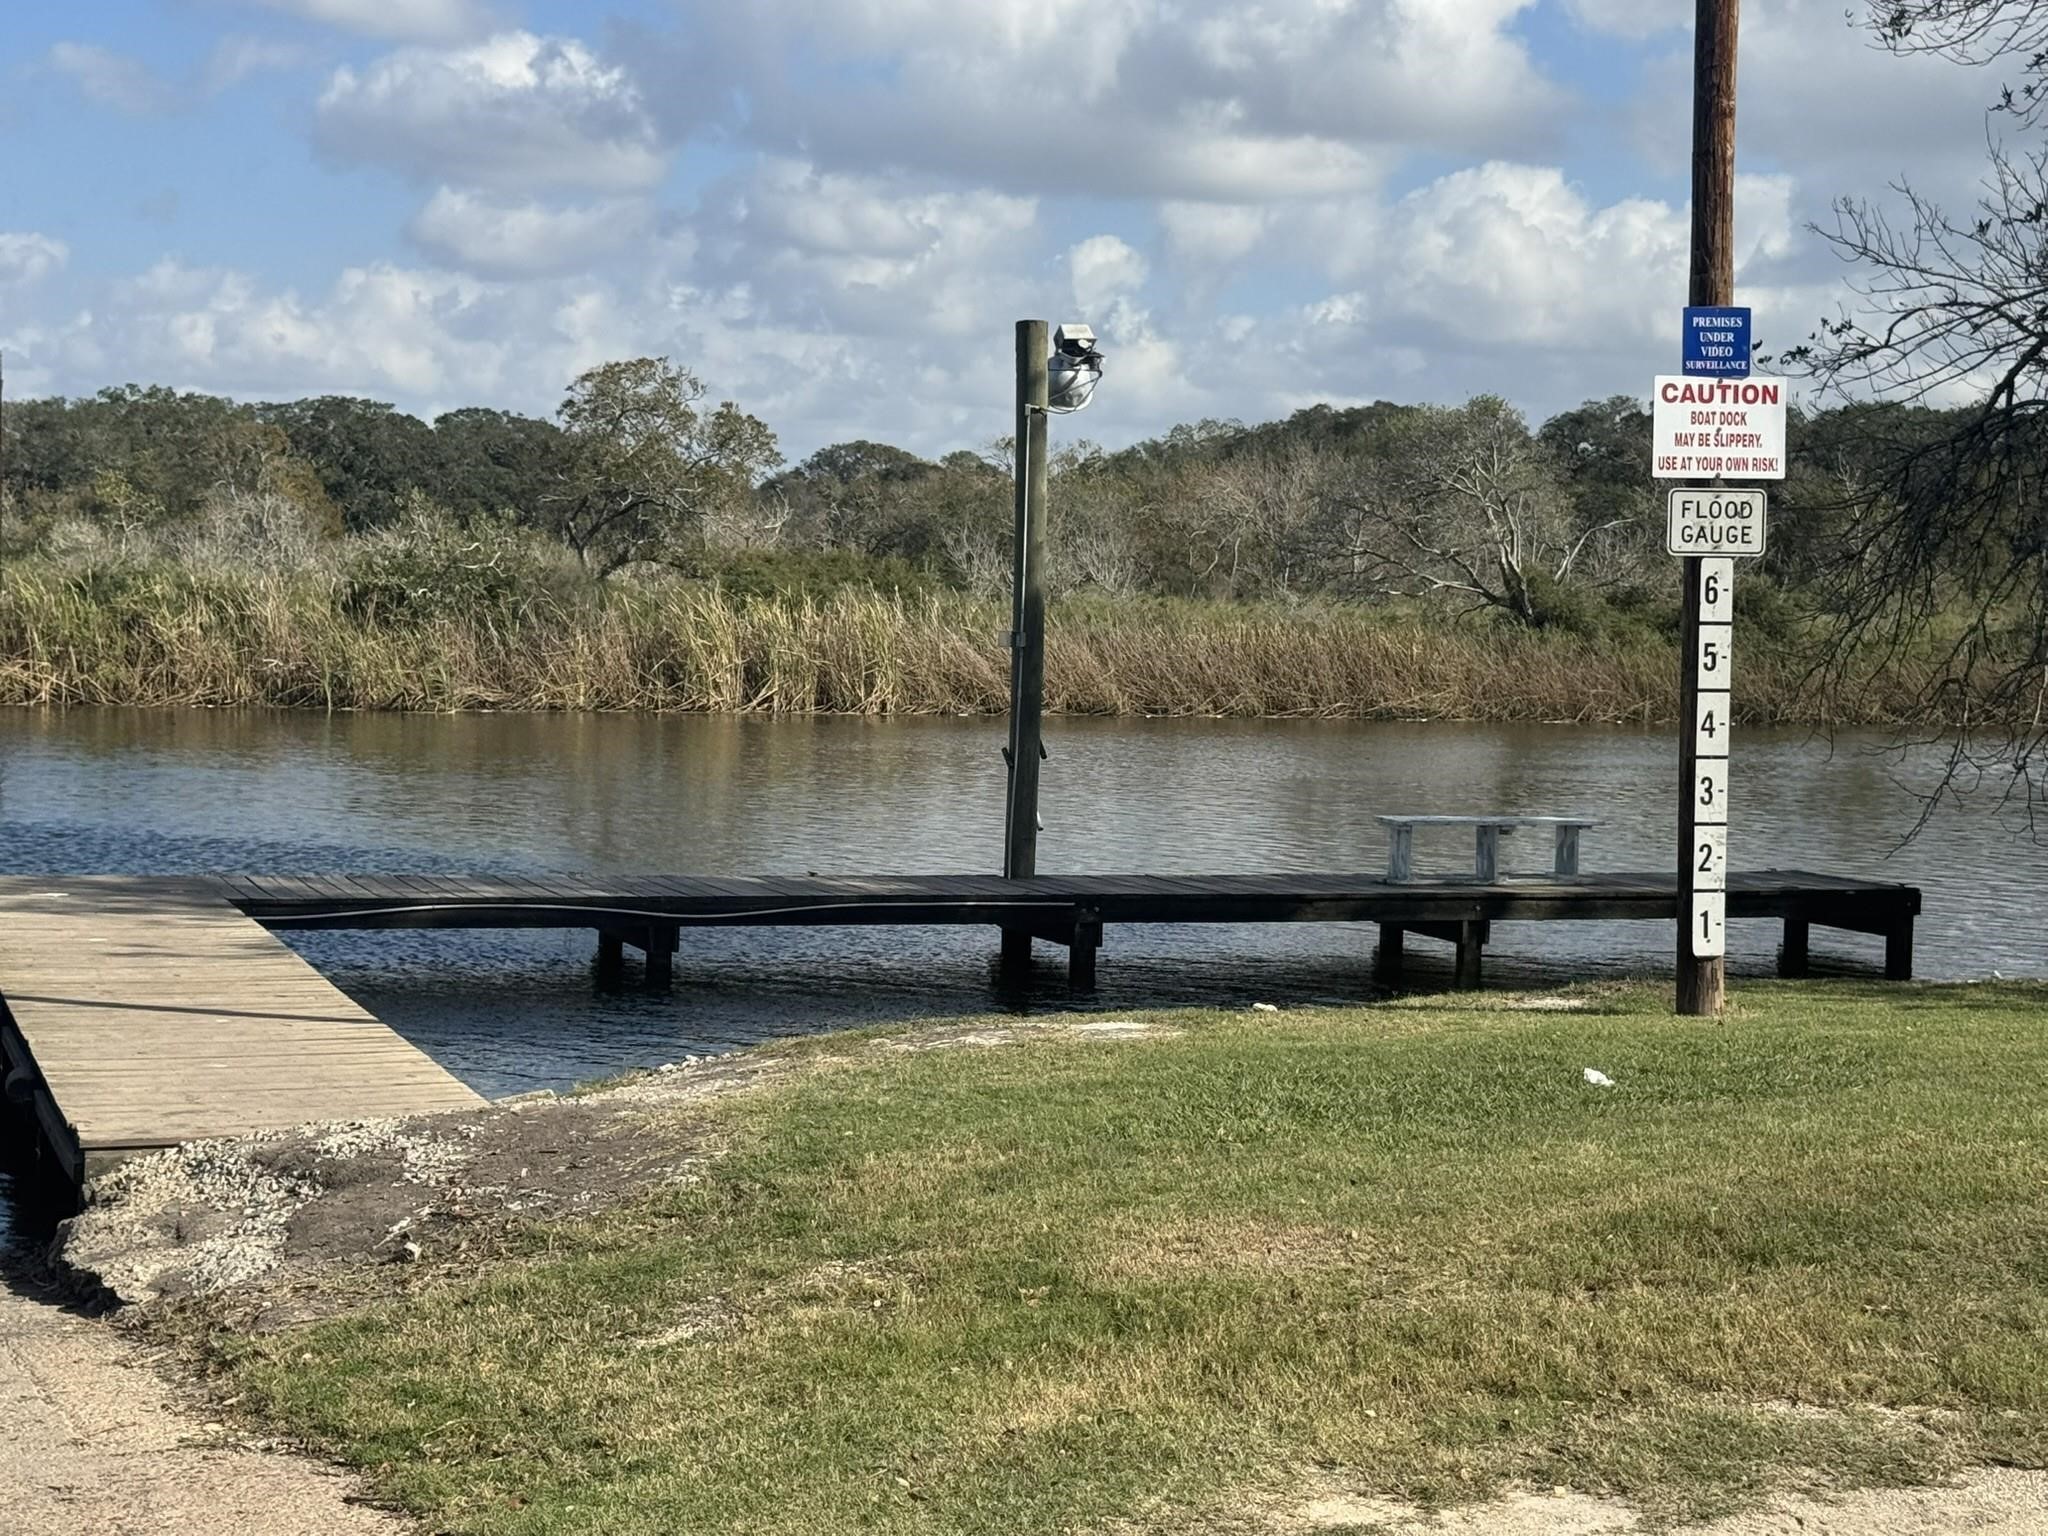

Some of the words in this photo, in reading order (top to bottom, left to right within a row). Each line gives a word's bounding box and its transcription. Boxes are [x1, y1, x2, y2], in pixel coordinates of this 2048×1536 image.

[1692, 316, 1743, 328] PREMISES
[1700, 331, 1735, 343] UNDER
[1700, 346, 1733, 357] VIDEO
[1685, 360, 1748, 370] SURVEILLANCE
[1661, 383, 1779, 405] CAUTION
[1690, 411, 1717, 426] BOAT
[1719, 411, 1748, 426] DOCK
[1674, 432, 1696, 447] MAY
[1698, 433, 1711, 447] BE
[1713, 432, 1763, 448] SLIPPERY.
[1658, 456, 1678, 471] USE
[1680, 456, 1693, 471] AT
[1695, 457, 1723, 472] YOUR
[1725, 457, 1749, 472] OWN
[1751, 457, 1779, 472] RISK!
[1681, 500, 1753, 519] FLOOD
[1681, 525, 1753, 544] GAUGE
